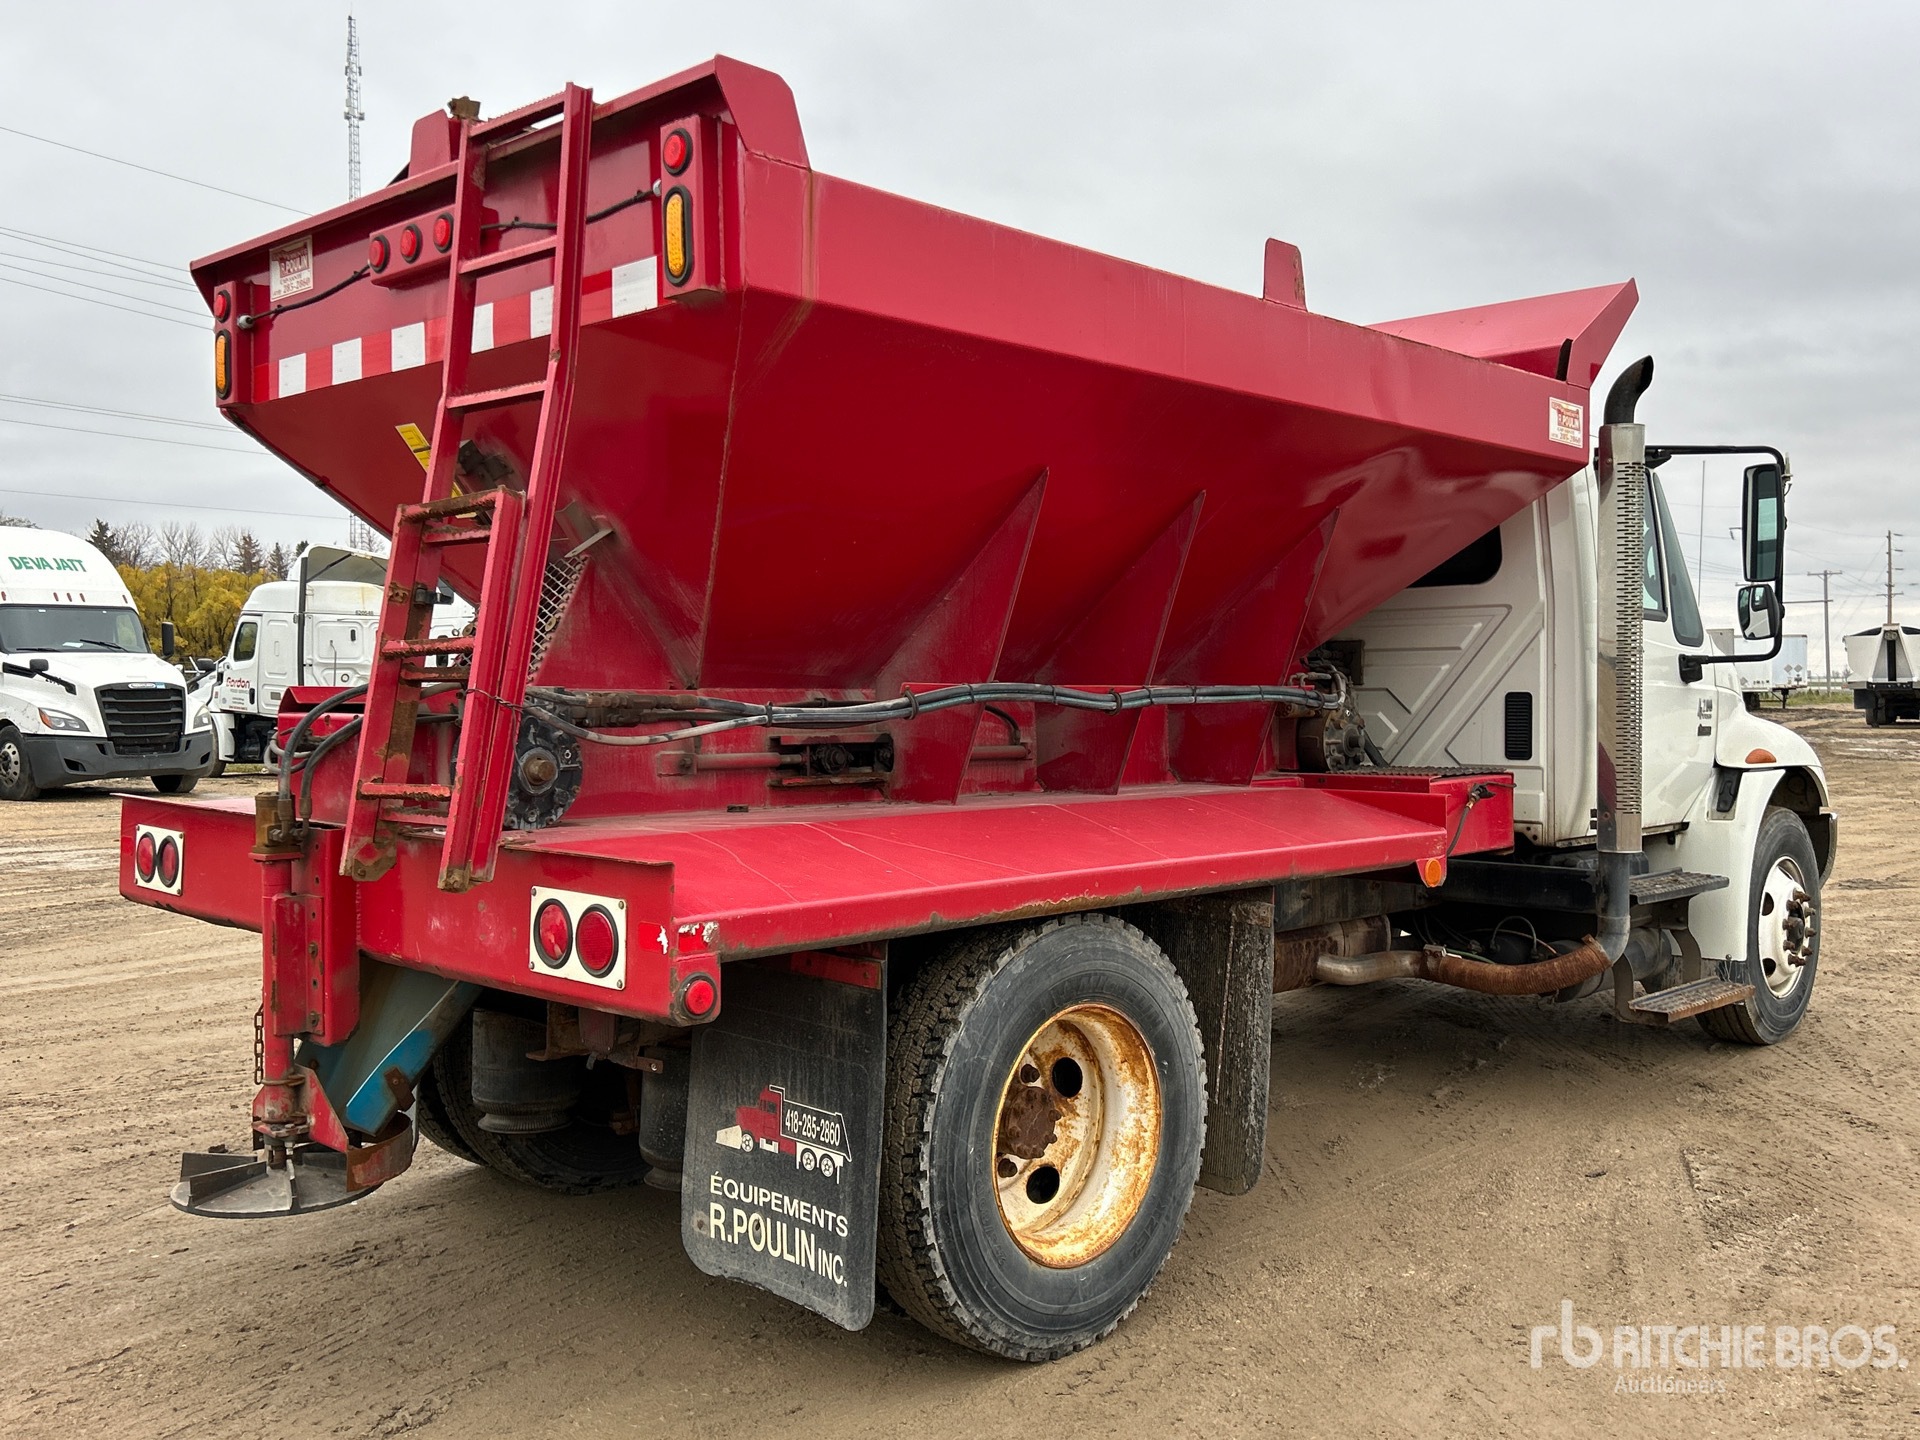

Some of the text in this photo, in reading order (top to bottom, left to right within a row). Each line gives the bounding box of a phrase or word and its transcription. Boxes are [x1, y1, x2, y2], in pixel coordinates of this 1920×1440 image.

[8, 557, 87, 572] DEVA JATT
[226, 677, 250, 689] Gordon
[785, 1108, 841, 1147] 418-285-2860
[710, 1170, 849, 1238] ÉQUIPEMENTS
[709, 1202, 849, 1288] R.POULIN INC.
